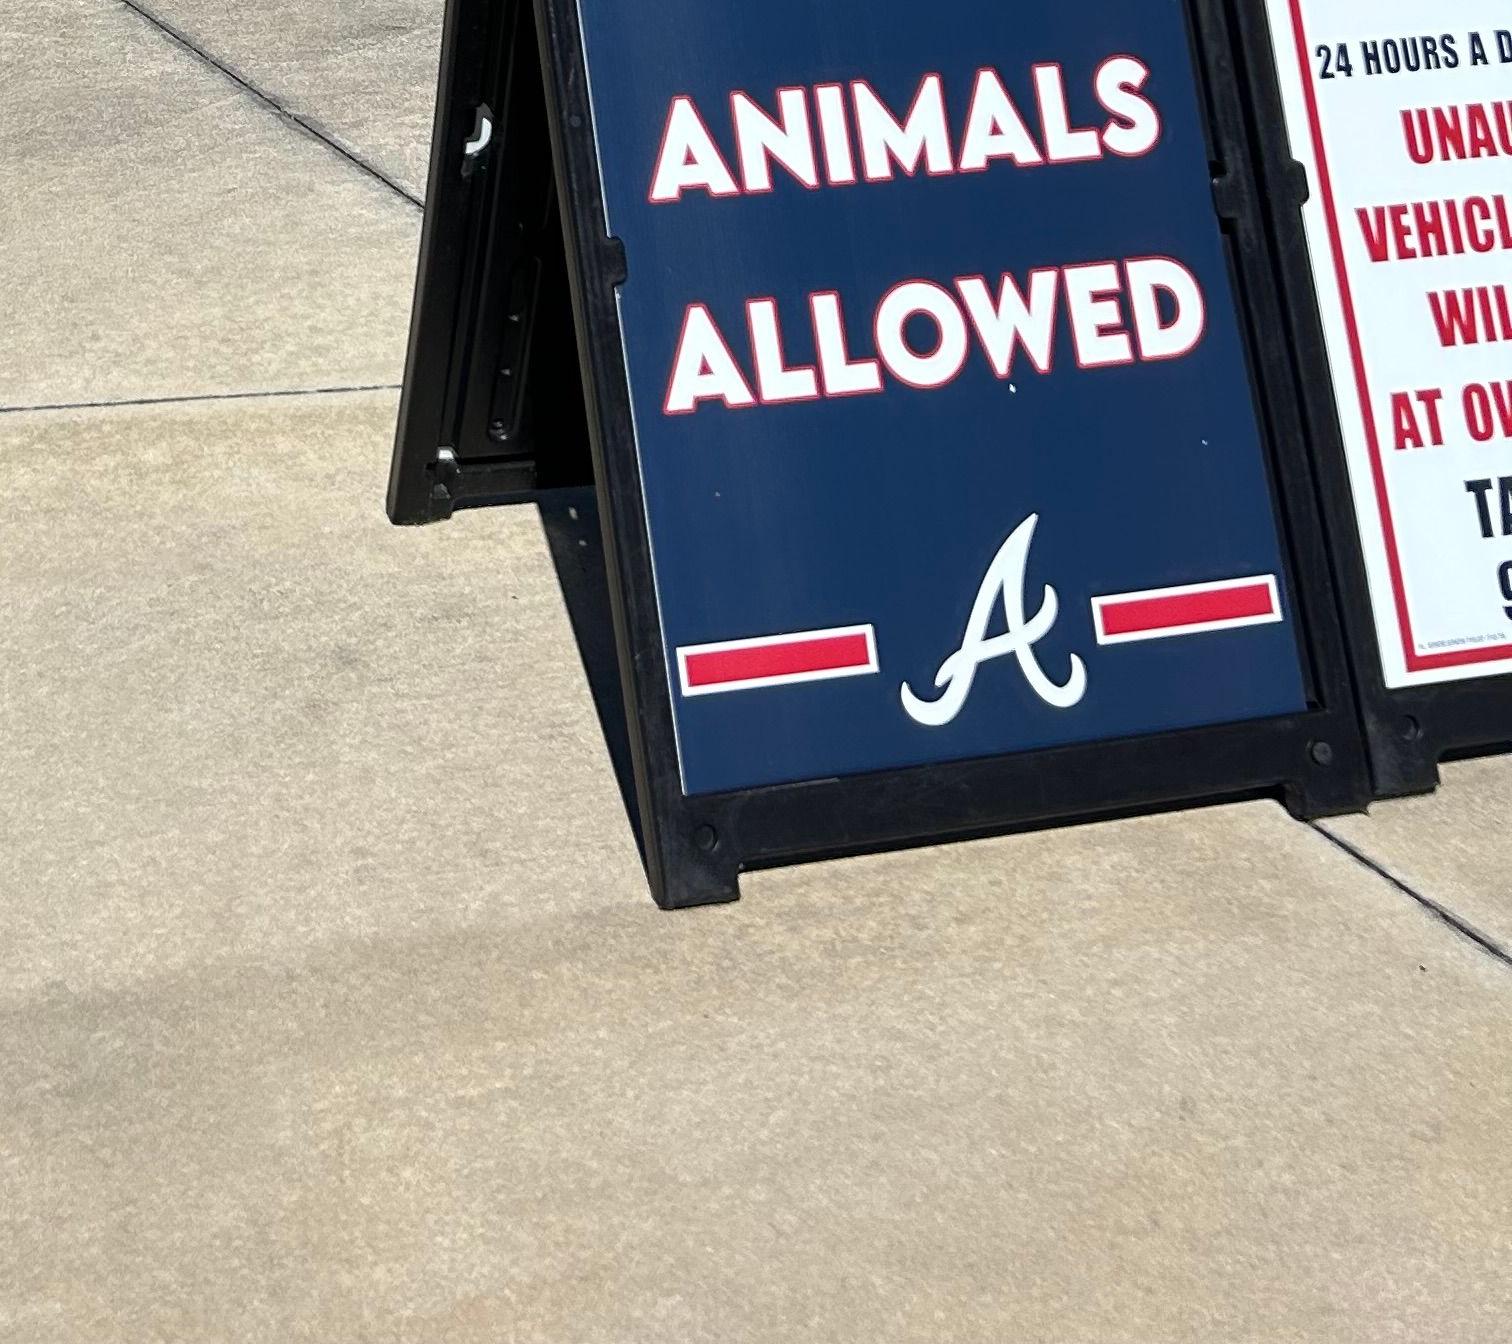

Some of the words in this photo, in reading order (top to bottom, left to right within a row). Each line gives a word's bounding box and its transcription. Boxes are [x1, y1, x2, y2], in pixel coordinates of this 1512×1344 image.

[1315, 42, 1353, 80] 24
[1359, 33, 1460, 76] HOURS
[1467, 31, 1489, 66] A
[648, 55, 1160, 203] ANIMALS
[1354, 194, 1512, 263] VEHICL
[664, 255, 1206, 414] ALLOWED
[1425, 284, 1512, 348] WIL
[1390, 387, 1444, 450] AT
